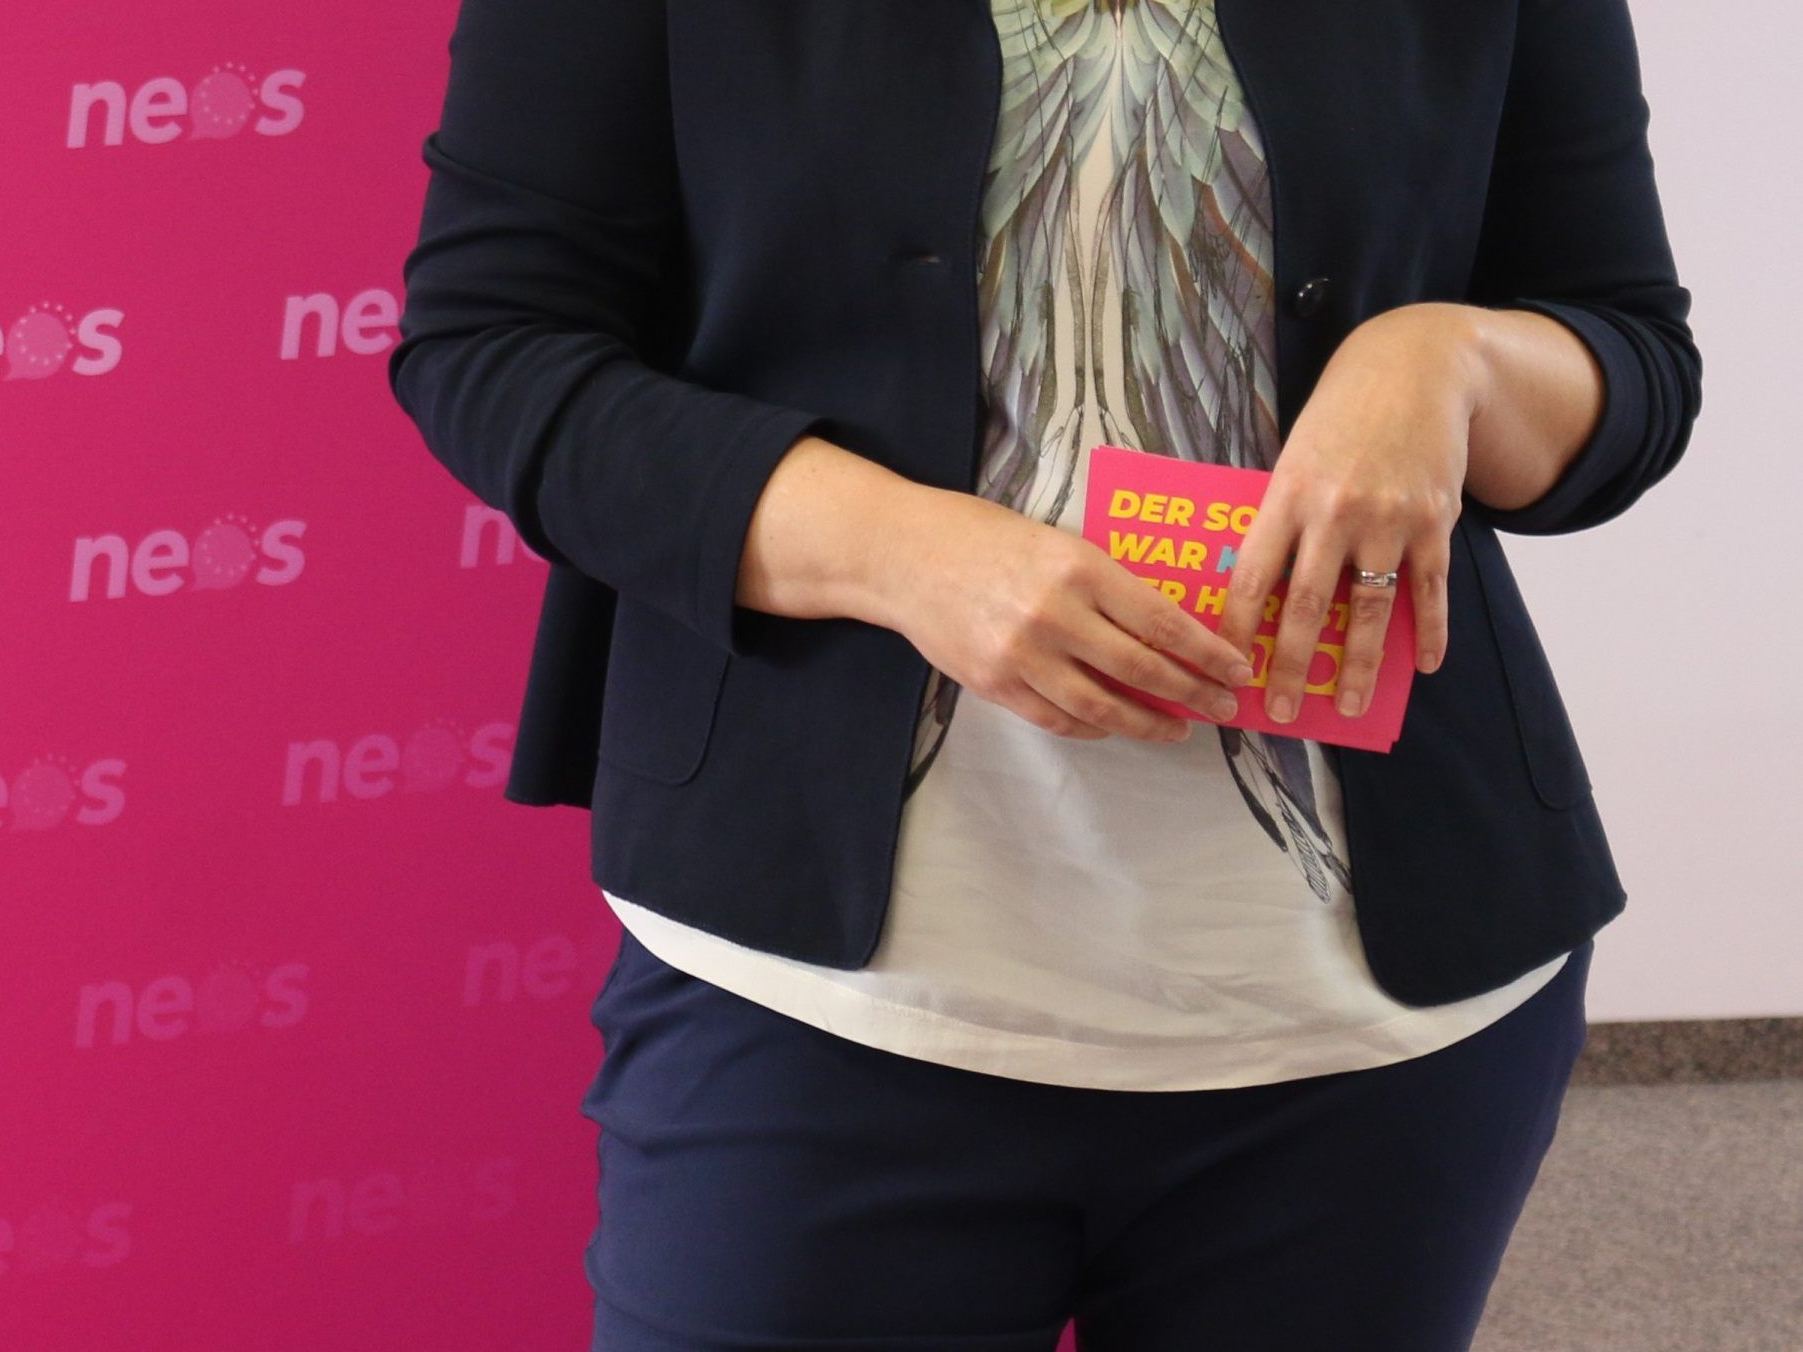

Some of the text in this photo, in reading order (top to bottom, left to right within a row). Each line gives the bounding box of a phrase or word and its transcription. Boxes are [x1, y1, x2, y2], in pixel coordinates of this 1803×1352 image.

[67, 69, 305, 148] neos
[1108, 489, 1195, 528] DER
[70, 519, 305, 601] neos
[1109, 531, 1208, 571] WAR
[282, 720, 510, 805] neos
[75, 963, 308, 1047] neos
